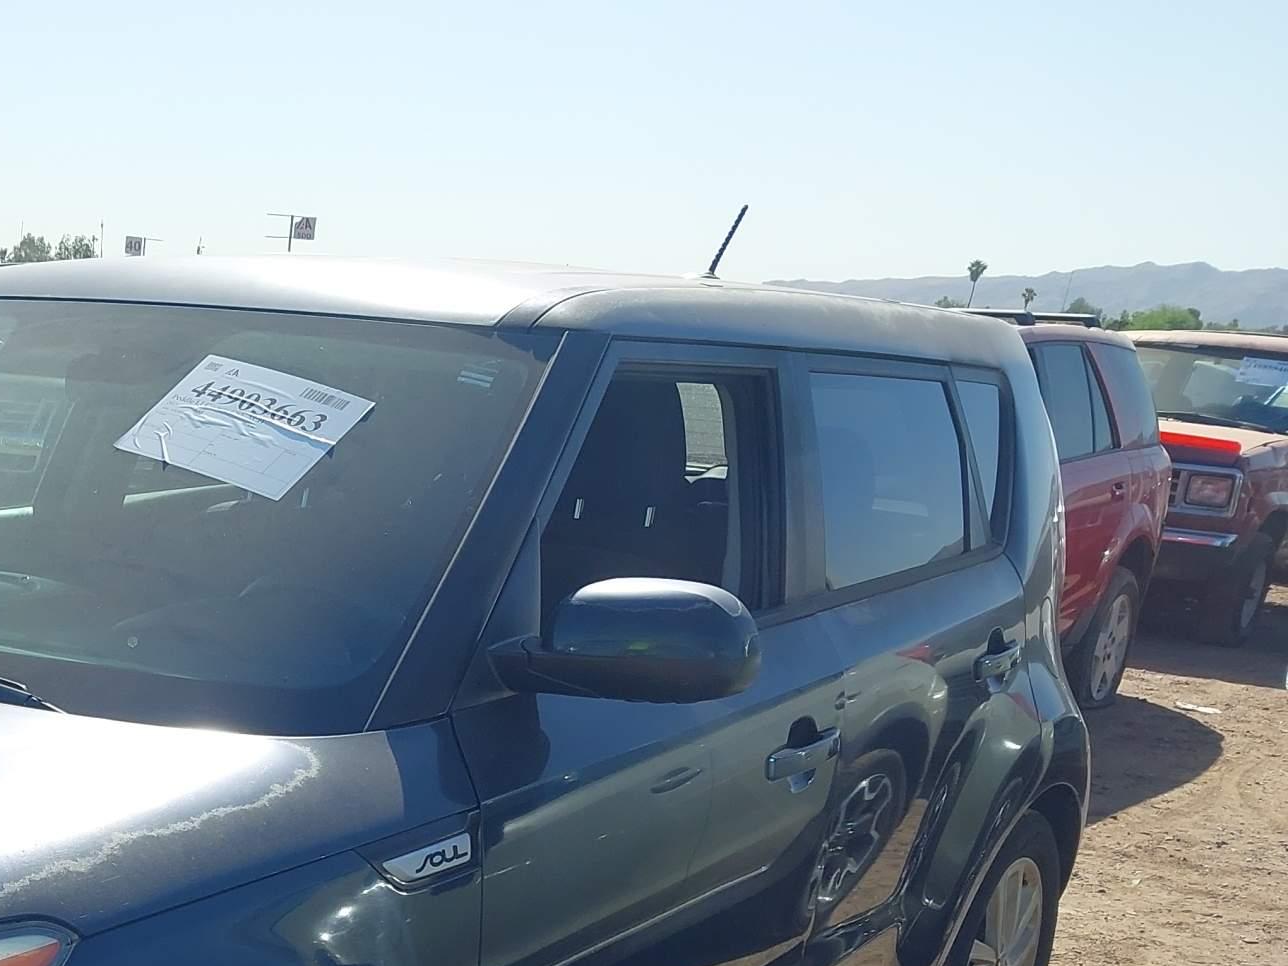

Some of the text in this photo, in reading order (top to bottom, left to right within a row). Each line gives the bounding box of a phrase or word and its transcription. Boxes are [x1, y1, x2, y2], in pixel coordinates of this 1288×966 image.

[127, 240, 142, 252] 40
[191, 381, 328, 433] 44903663
[415, 845, 468, 874] SOUL
